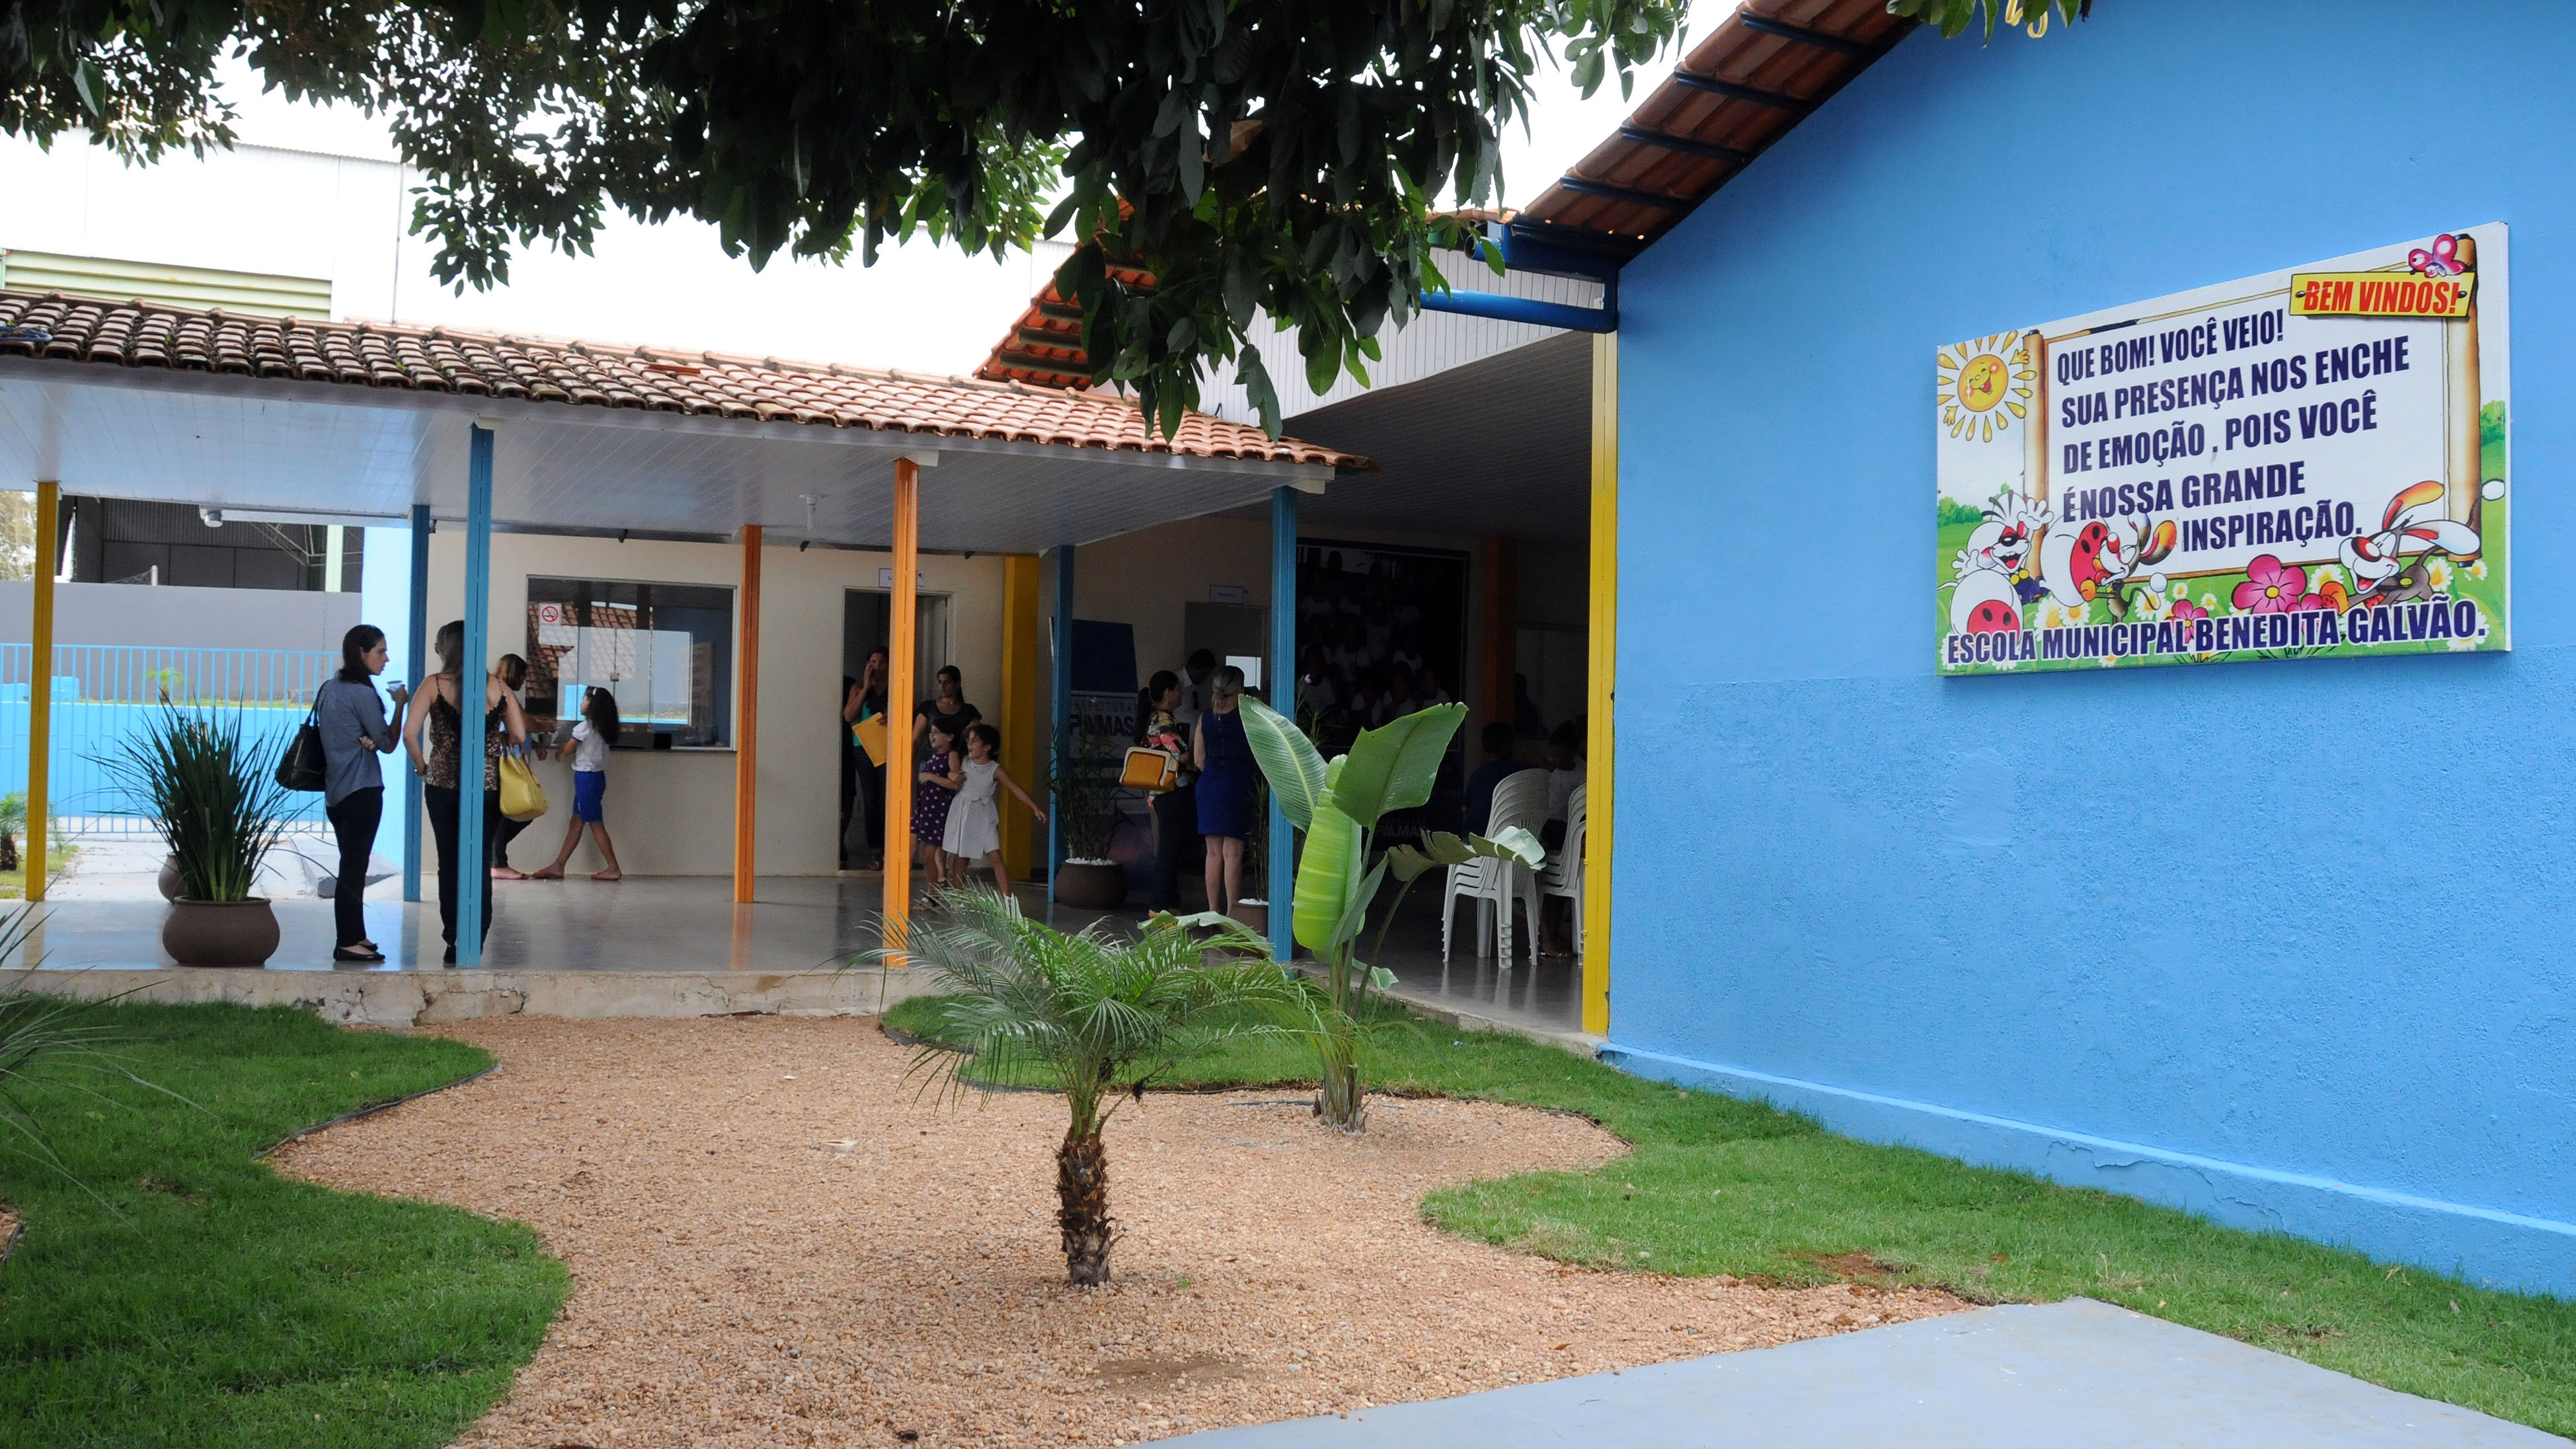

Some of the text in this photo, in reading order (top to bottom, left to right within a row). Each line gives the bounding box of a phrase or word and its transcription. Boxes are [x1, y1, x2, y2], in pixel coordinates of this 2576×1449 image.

[2304, 280, 2460, 314] BEM VINDOS!
[2058, 309, 2283, 385] QUE BOM! VOCÊ VEIO!
[2062, 335, 2409, 428] SUA PRESENÇA NOS ENCHE
[2064, 440, 2091, 474] DE
[2099, 420, 2205, 467] EMOÇÃO
[2226, 409, 2290, 451] POIS
[2298, 389, 2378, 439] VOCÊ
[2181, 461, 2305, 508] GRANDE
[2183, 499, 2362, 552] INSPIRAÇÃO.
[1948, 594, 2485, 663] ESCOLA MUNICIPAL BENEDITA GALVÃO.
